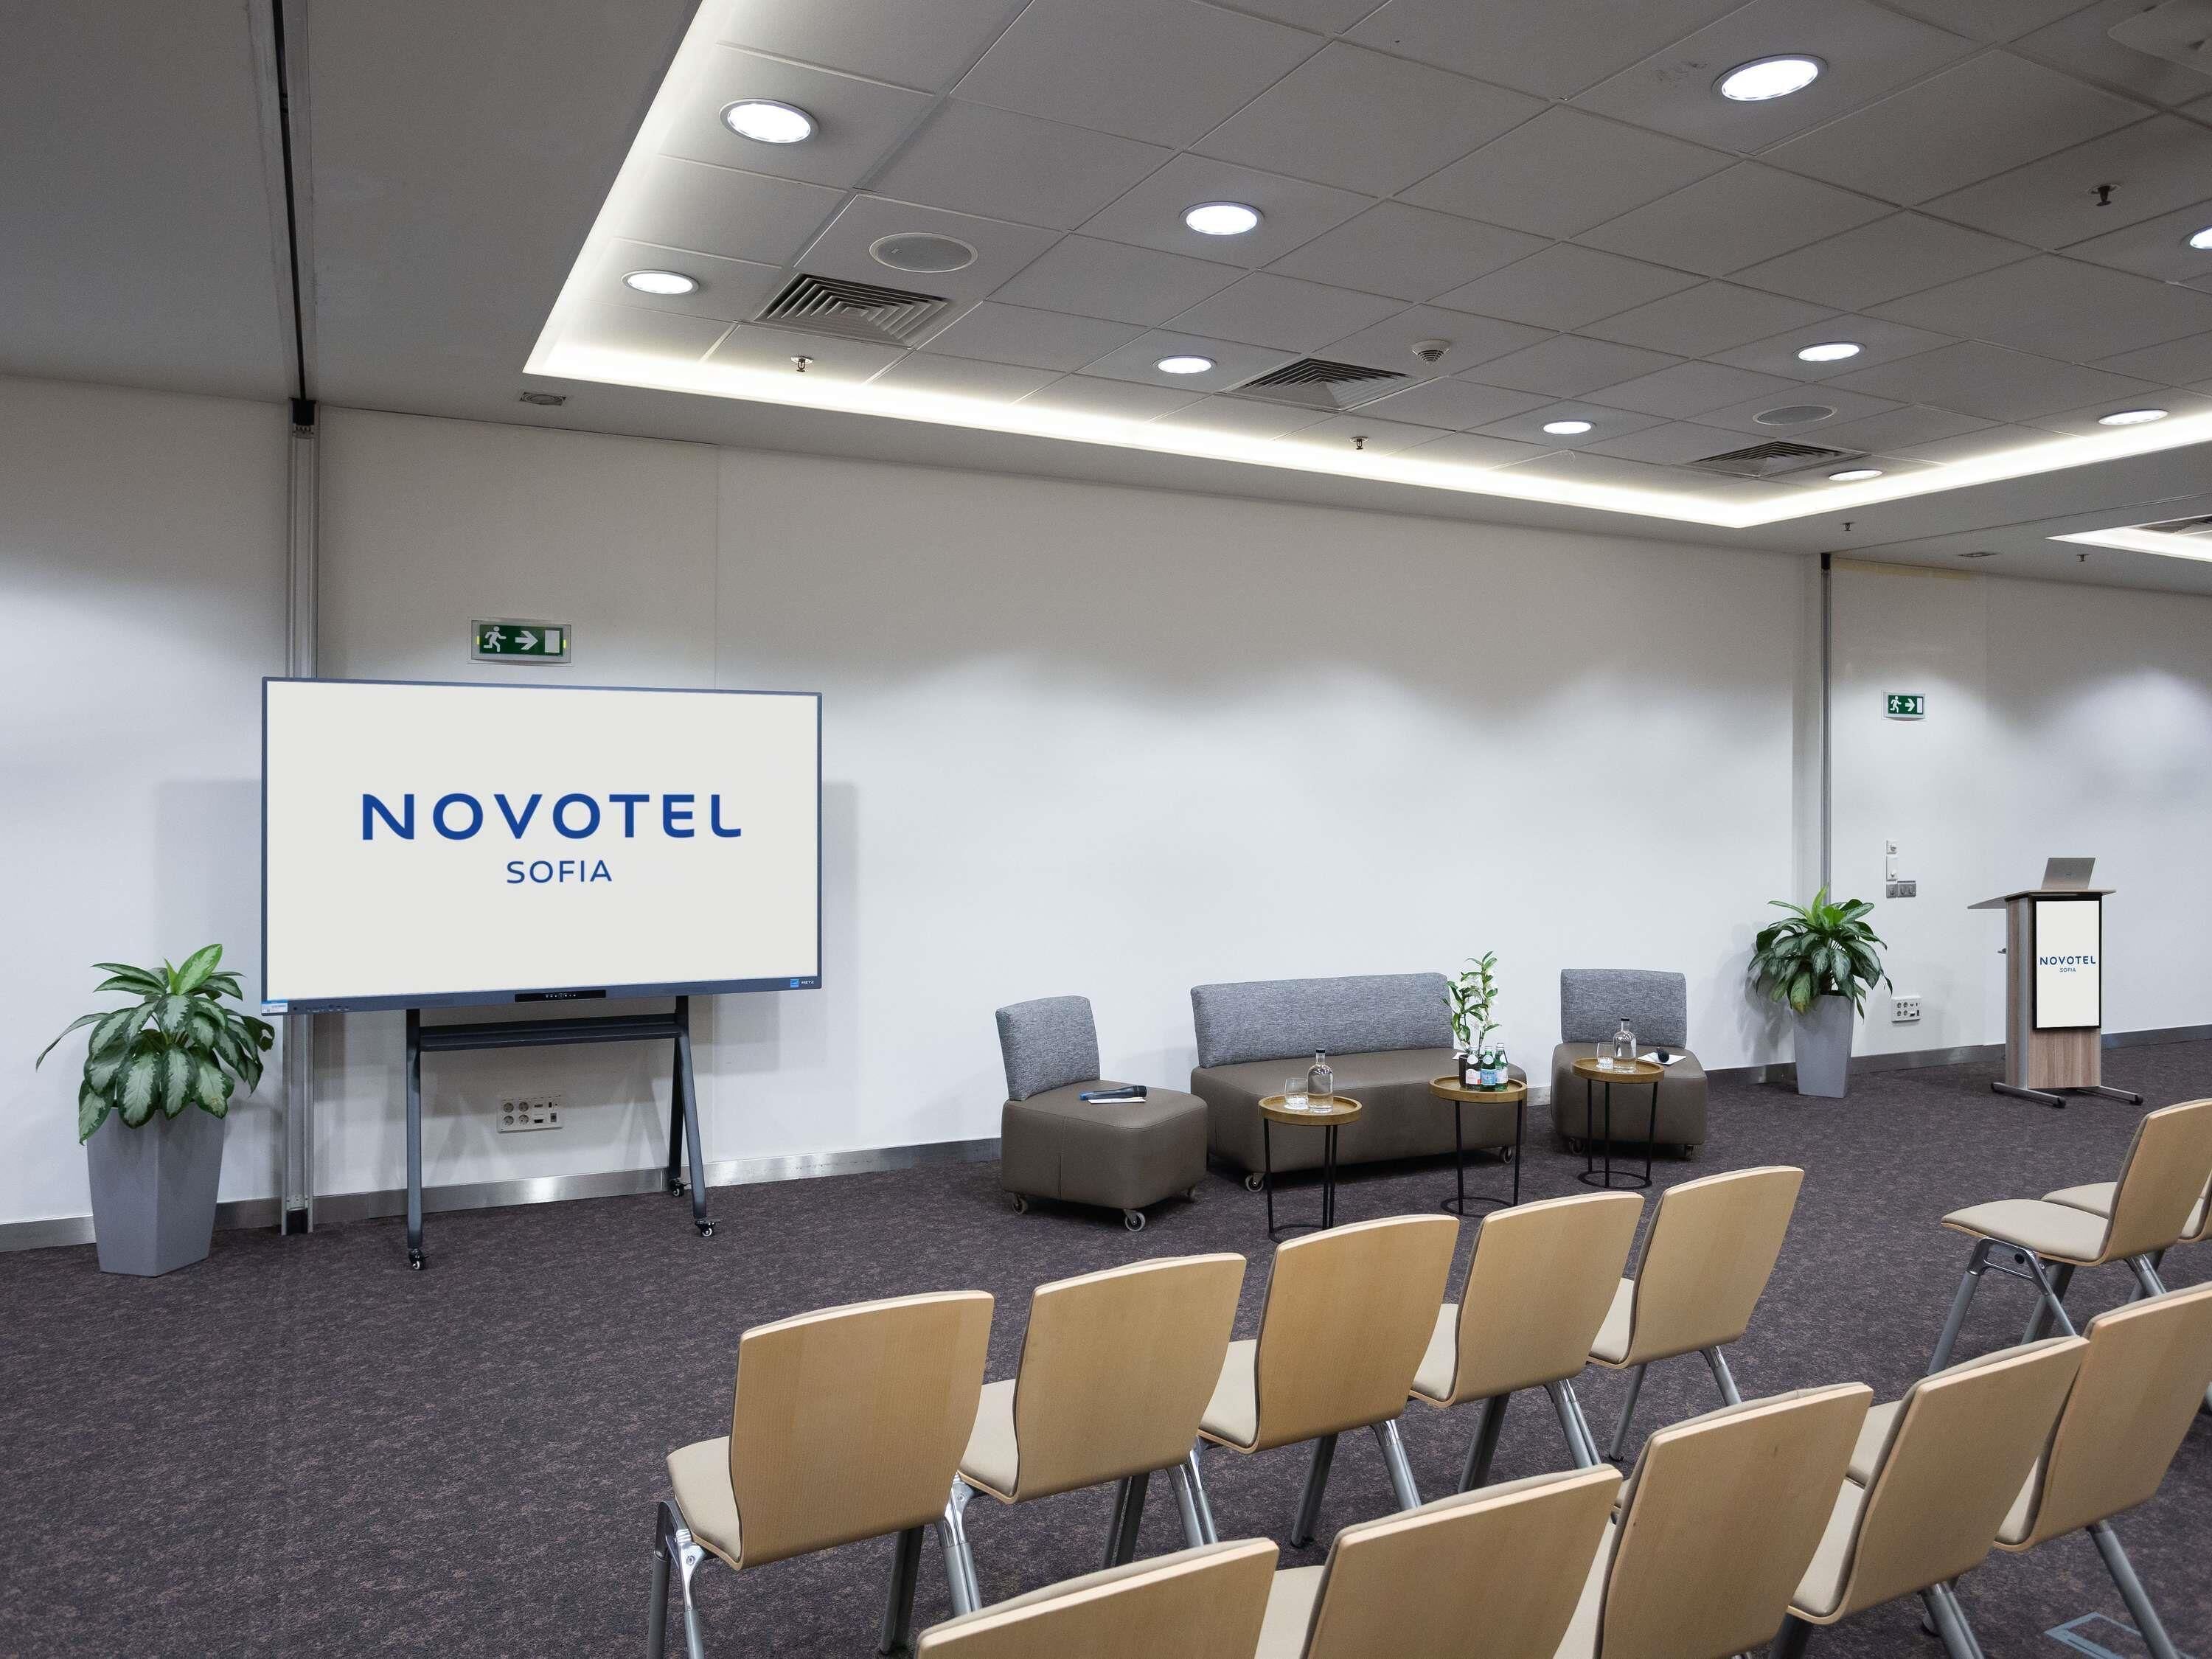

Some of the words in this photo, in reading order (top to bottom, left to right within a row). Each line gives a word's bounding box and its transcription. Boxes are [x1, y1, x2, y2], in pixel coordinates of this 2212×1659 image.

[362, 793, 742, 841] NOVOTEL
[507, 860, 613, 884] SOFIA
[2039, 956, 2096, 966] NOVOTEL
